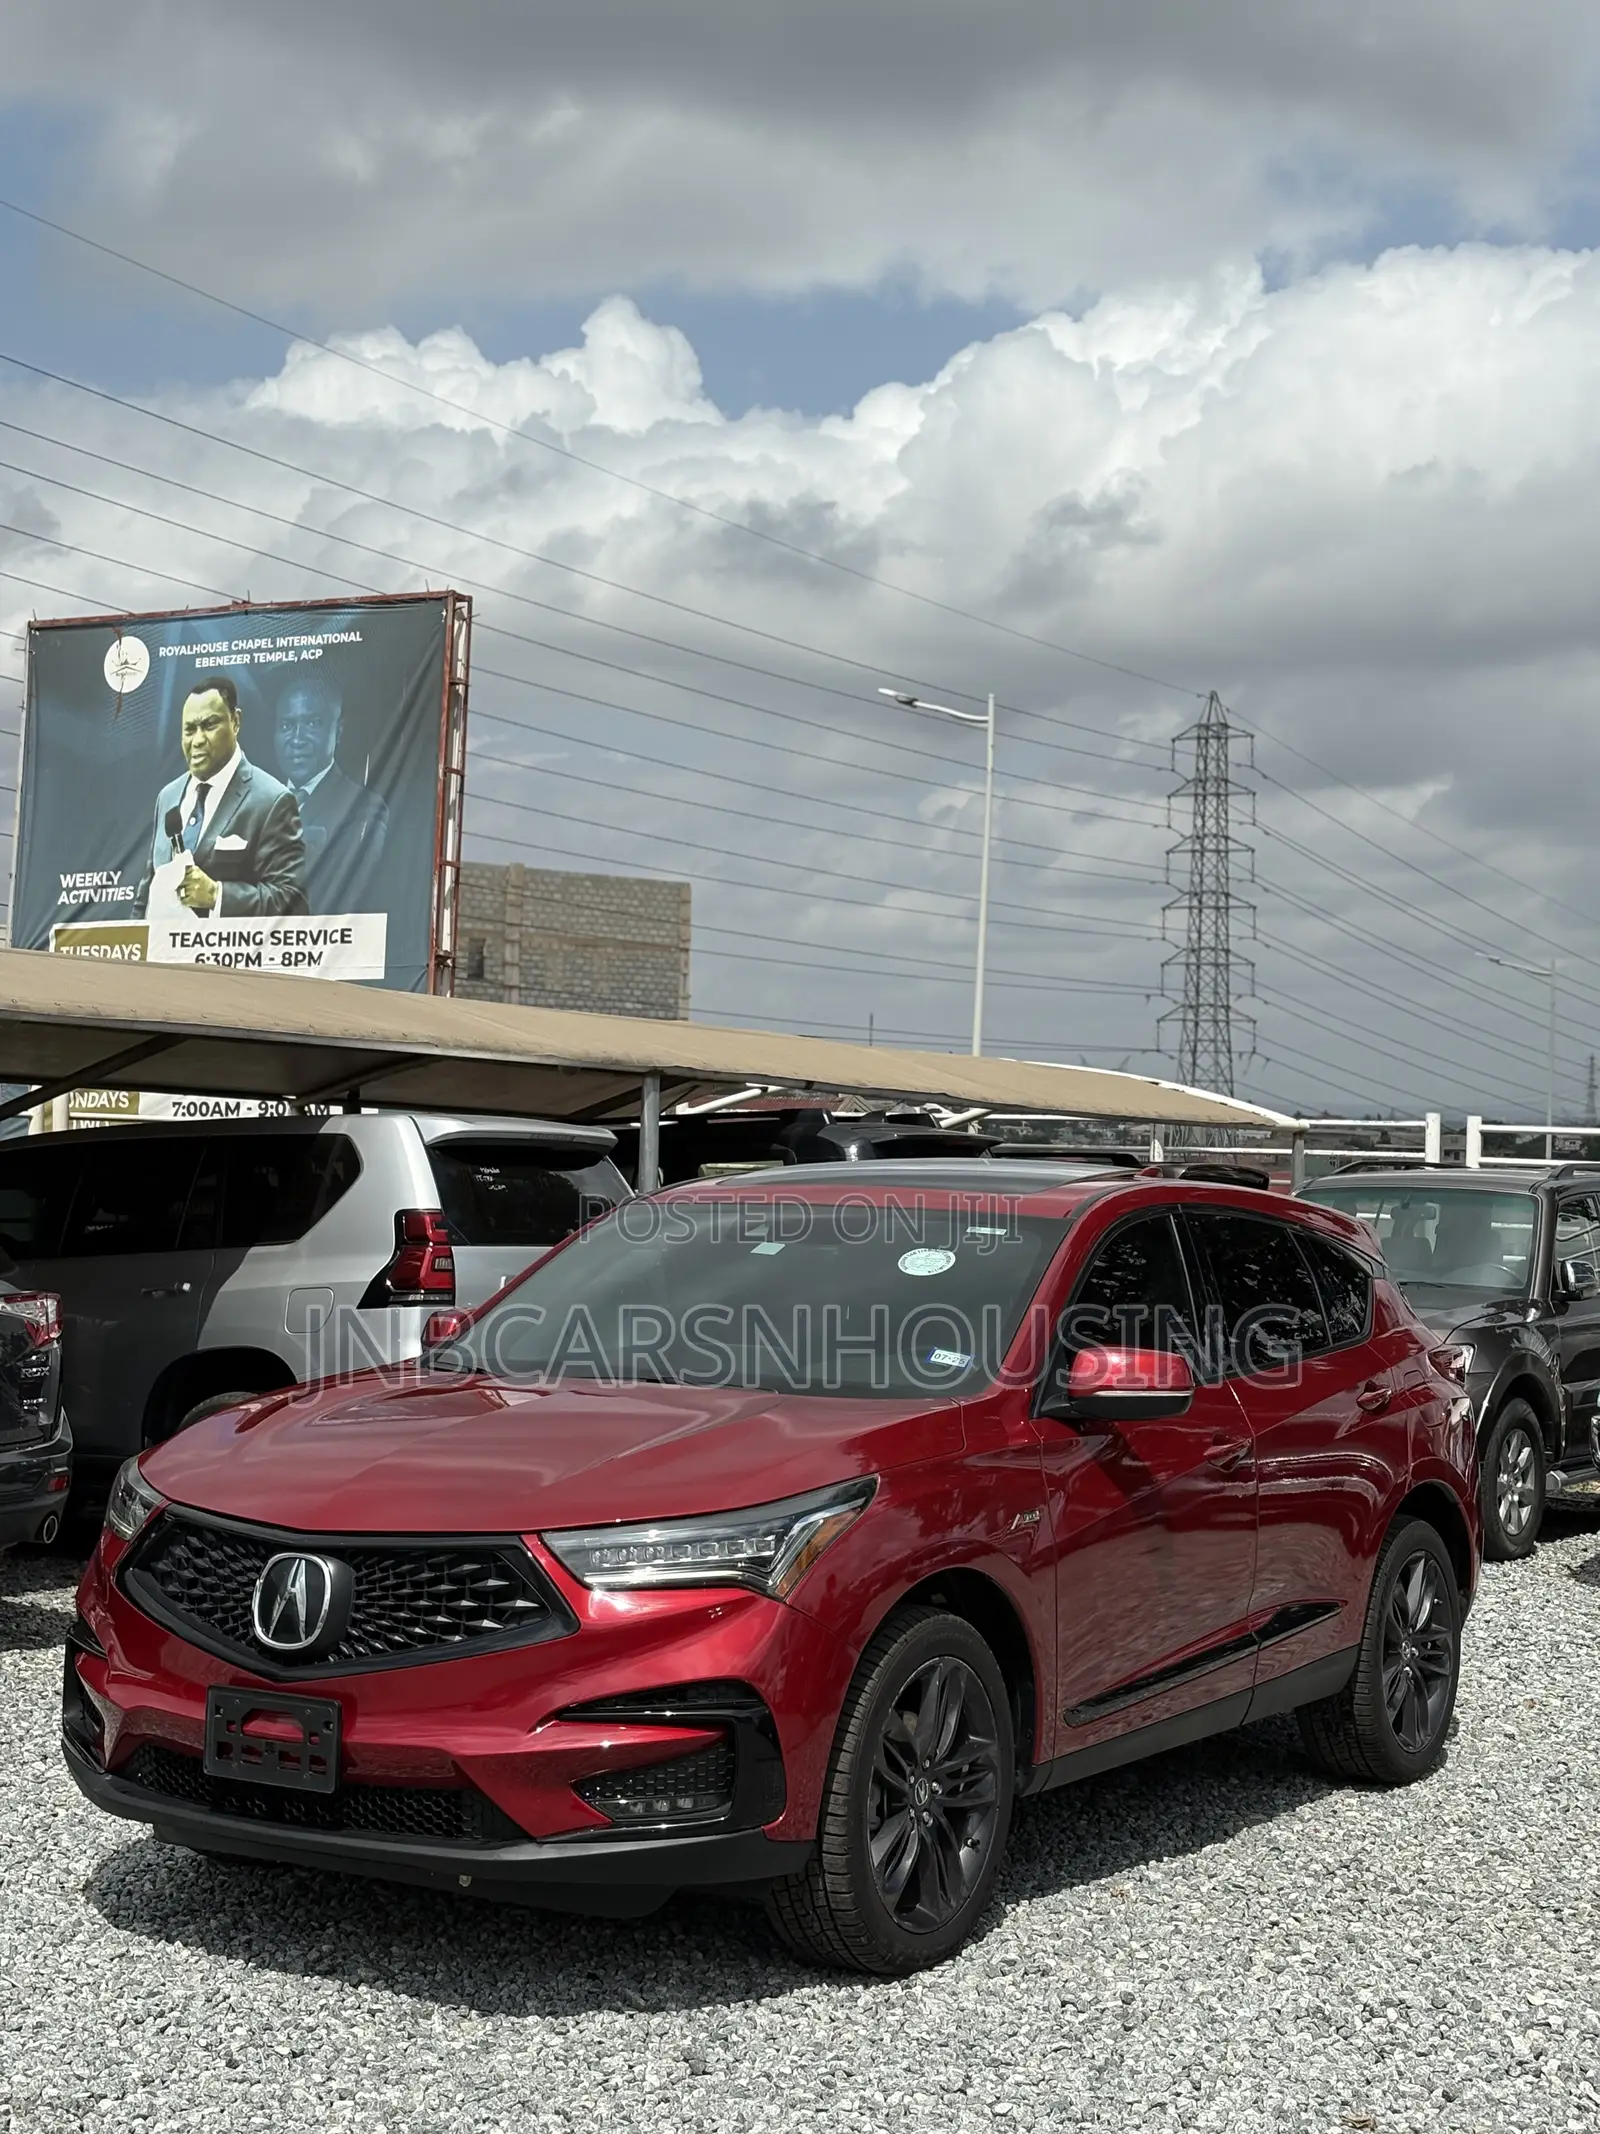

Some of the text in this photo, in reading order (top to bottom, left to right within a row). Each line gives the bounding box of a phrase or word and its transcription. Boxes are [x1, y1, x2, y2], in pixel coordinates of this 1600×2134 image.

[159, 631, 363, 657] ROYALHOUSE CHAPEL INTERNATIONAL
[195, 649, 323, 668] EBENEZER TEMPLE, ACP
[60, 871, 122, 888] WEEKLY
[57, 886, 135, 906] ACTIVITIES
[169, 928, 353, 948] TEACHING SERVICE
[194, 951, 262, 968] 6:30PM
[280, 951, 323, 967] 8PM
[172, 1101, 241, 1118] 7:00AM
